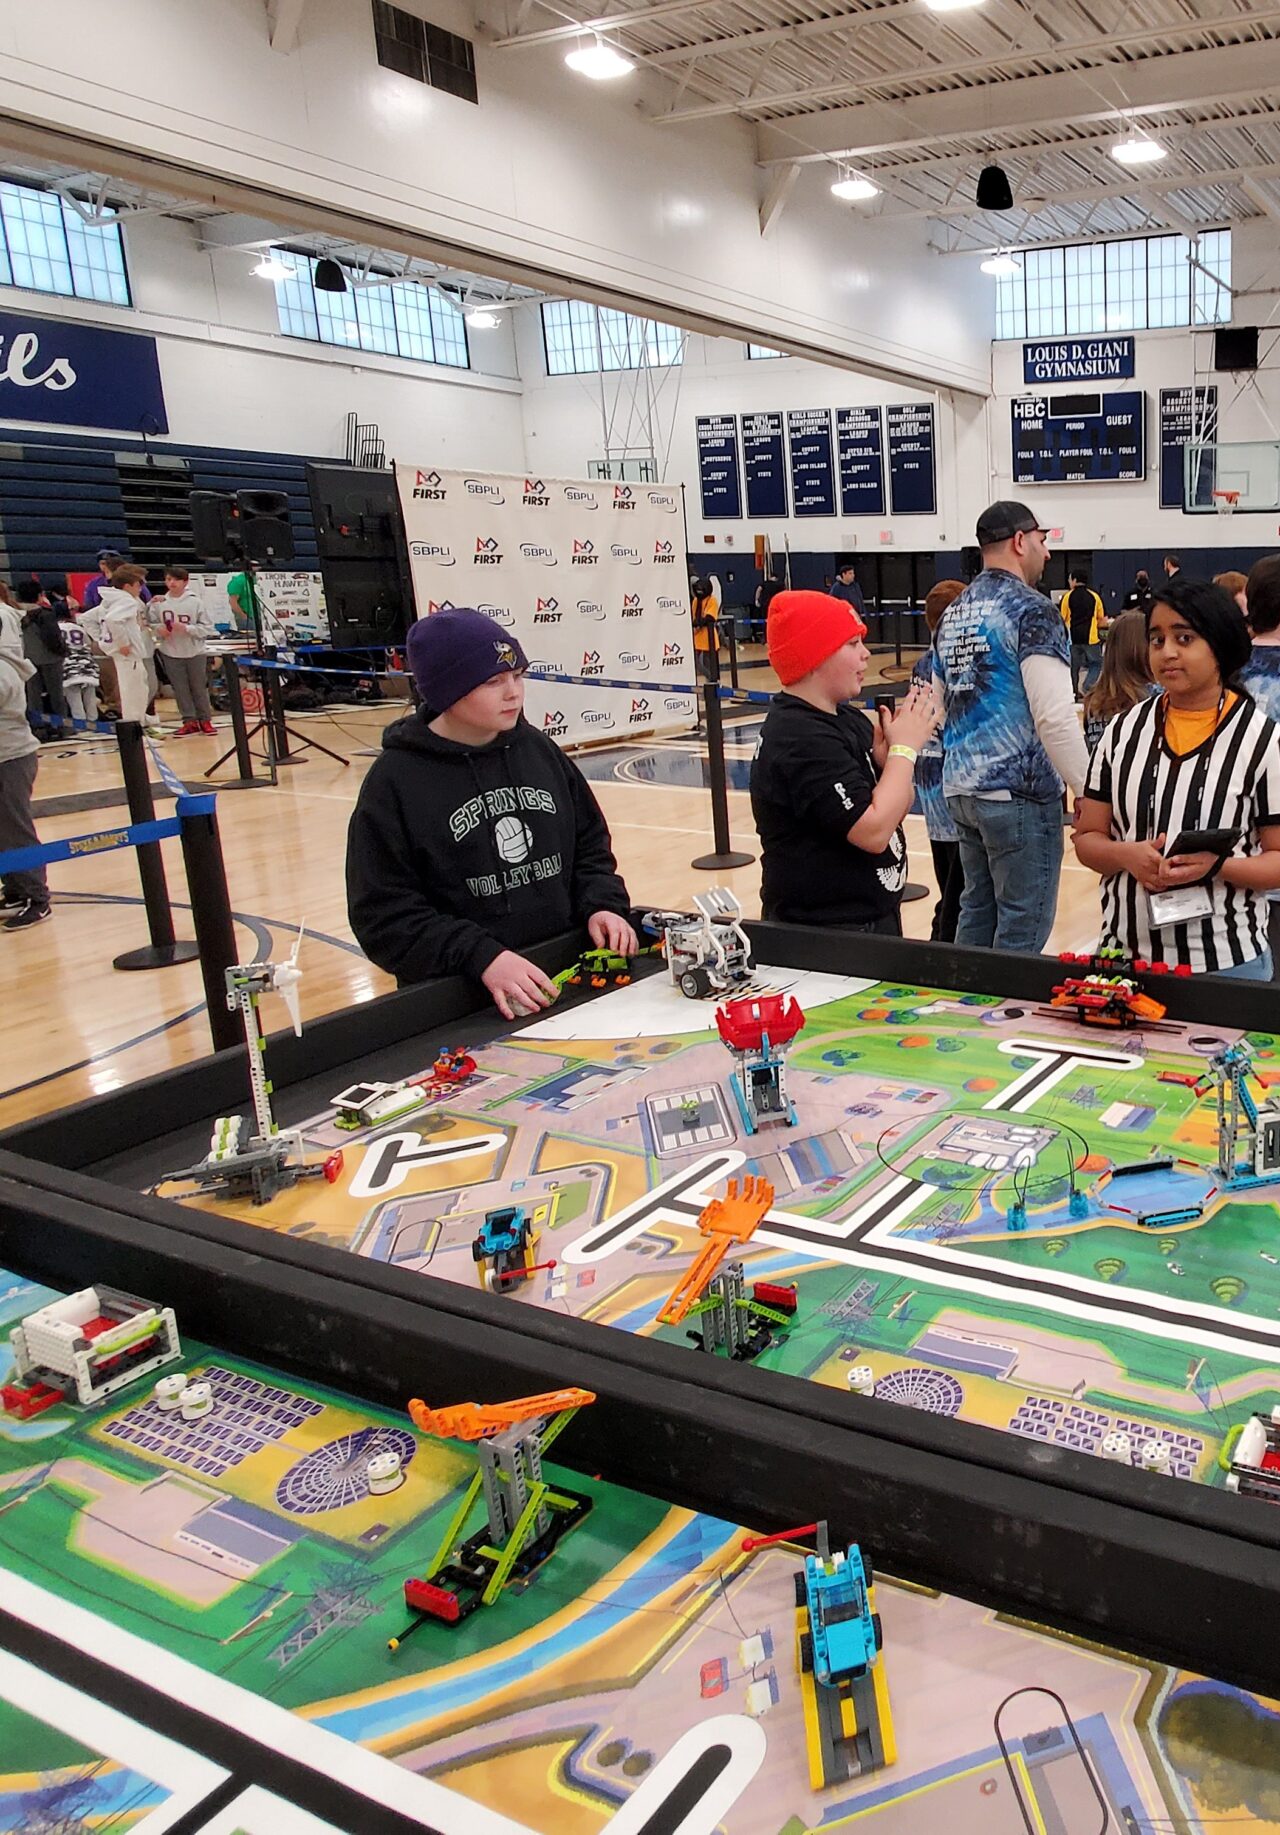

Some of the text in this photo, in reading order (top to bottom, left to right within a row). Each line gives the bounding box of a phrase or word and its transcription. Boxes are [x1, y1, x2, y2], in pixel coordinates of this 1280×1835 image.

[1027, 341, 1129, 363] LOUIS D. GIANI
[1035, 359, 1120, 378] GYMNASIUM
[1014, 403, 1045, 418] HBC
[1021, 420, 1043, 430] HOME
[1106, 415, 1132, 426] GUEST
[1065, 422, 1085, 430] PERIOD
[1059, 448, 1093, 457] PLAYER FOUL
[1119, 446, 1136, 454] FOULS
[1017, 451, 1034, 459] FOULS
[1018, 474, 1035, 482] SCORE
[1066, 472, 1085, 480] MATCH
[1119, 471, 1136, 479] SCORE
[413, 488, 447, 500] FIRST
[467, 484, 500, 495] SBPLI
[567, 492, 594, 500] SBPLI
[523, 496, 550, 506] FIRST
[613, 500, 636, 510] FIRST
[650, 497, 673, 505] SBPLI
[413, 547, 450, 555] SBPLI
[523, 548, 552, 556] SBPLI
[612, 549, 638, 557] SBPLI
[474, 555, 503, 564] FIRST
[572, 556, 599, 564] FIRST
[653, 555, 675, 563] FIRST
[659, 600, 682, 608] SBPLI
[580, 605, 603, 613] SBPLI
[621, 608, 644, 618] FIRST
[533, 613, 563, 623] FIRST
[621, 655, 646, 663] SBPLI
[662, 656, 685, 666] FIRST
[532, 664, 563, 673] SBPLI
[581, 665, 605, 676] FIRST
[666, 700, 690, 710] SBPLI
[584, 713, 611, 723] SBPLI
[629, 712, 653, 723] FIRST
[450, 787, 557, 842] SPRINGS
